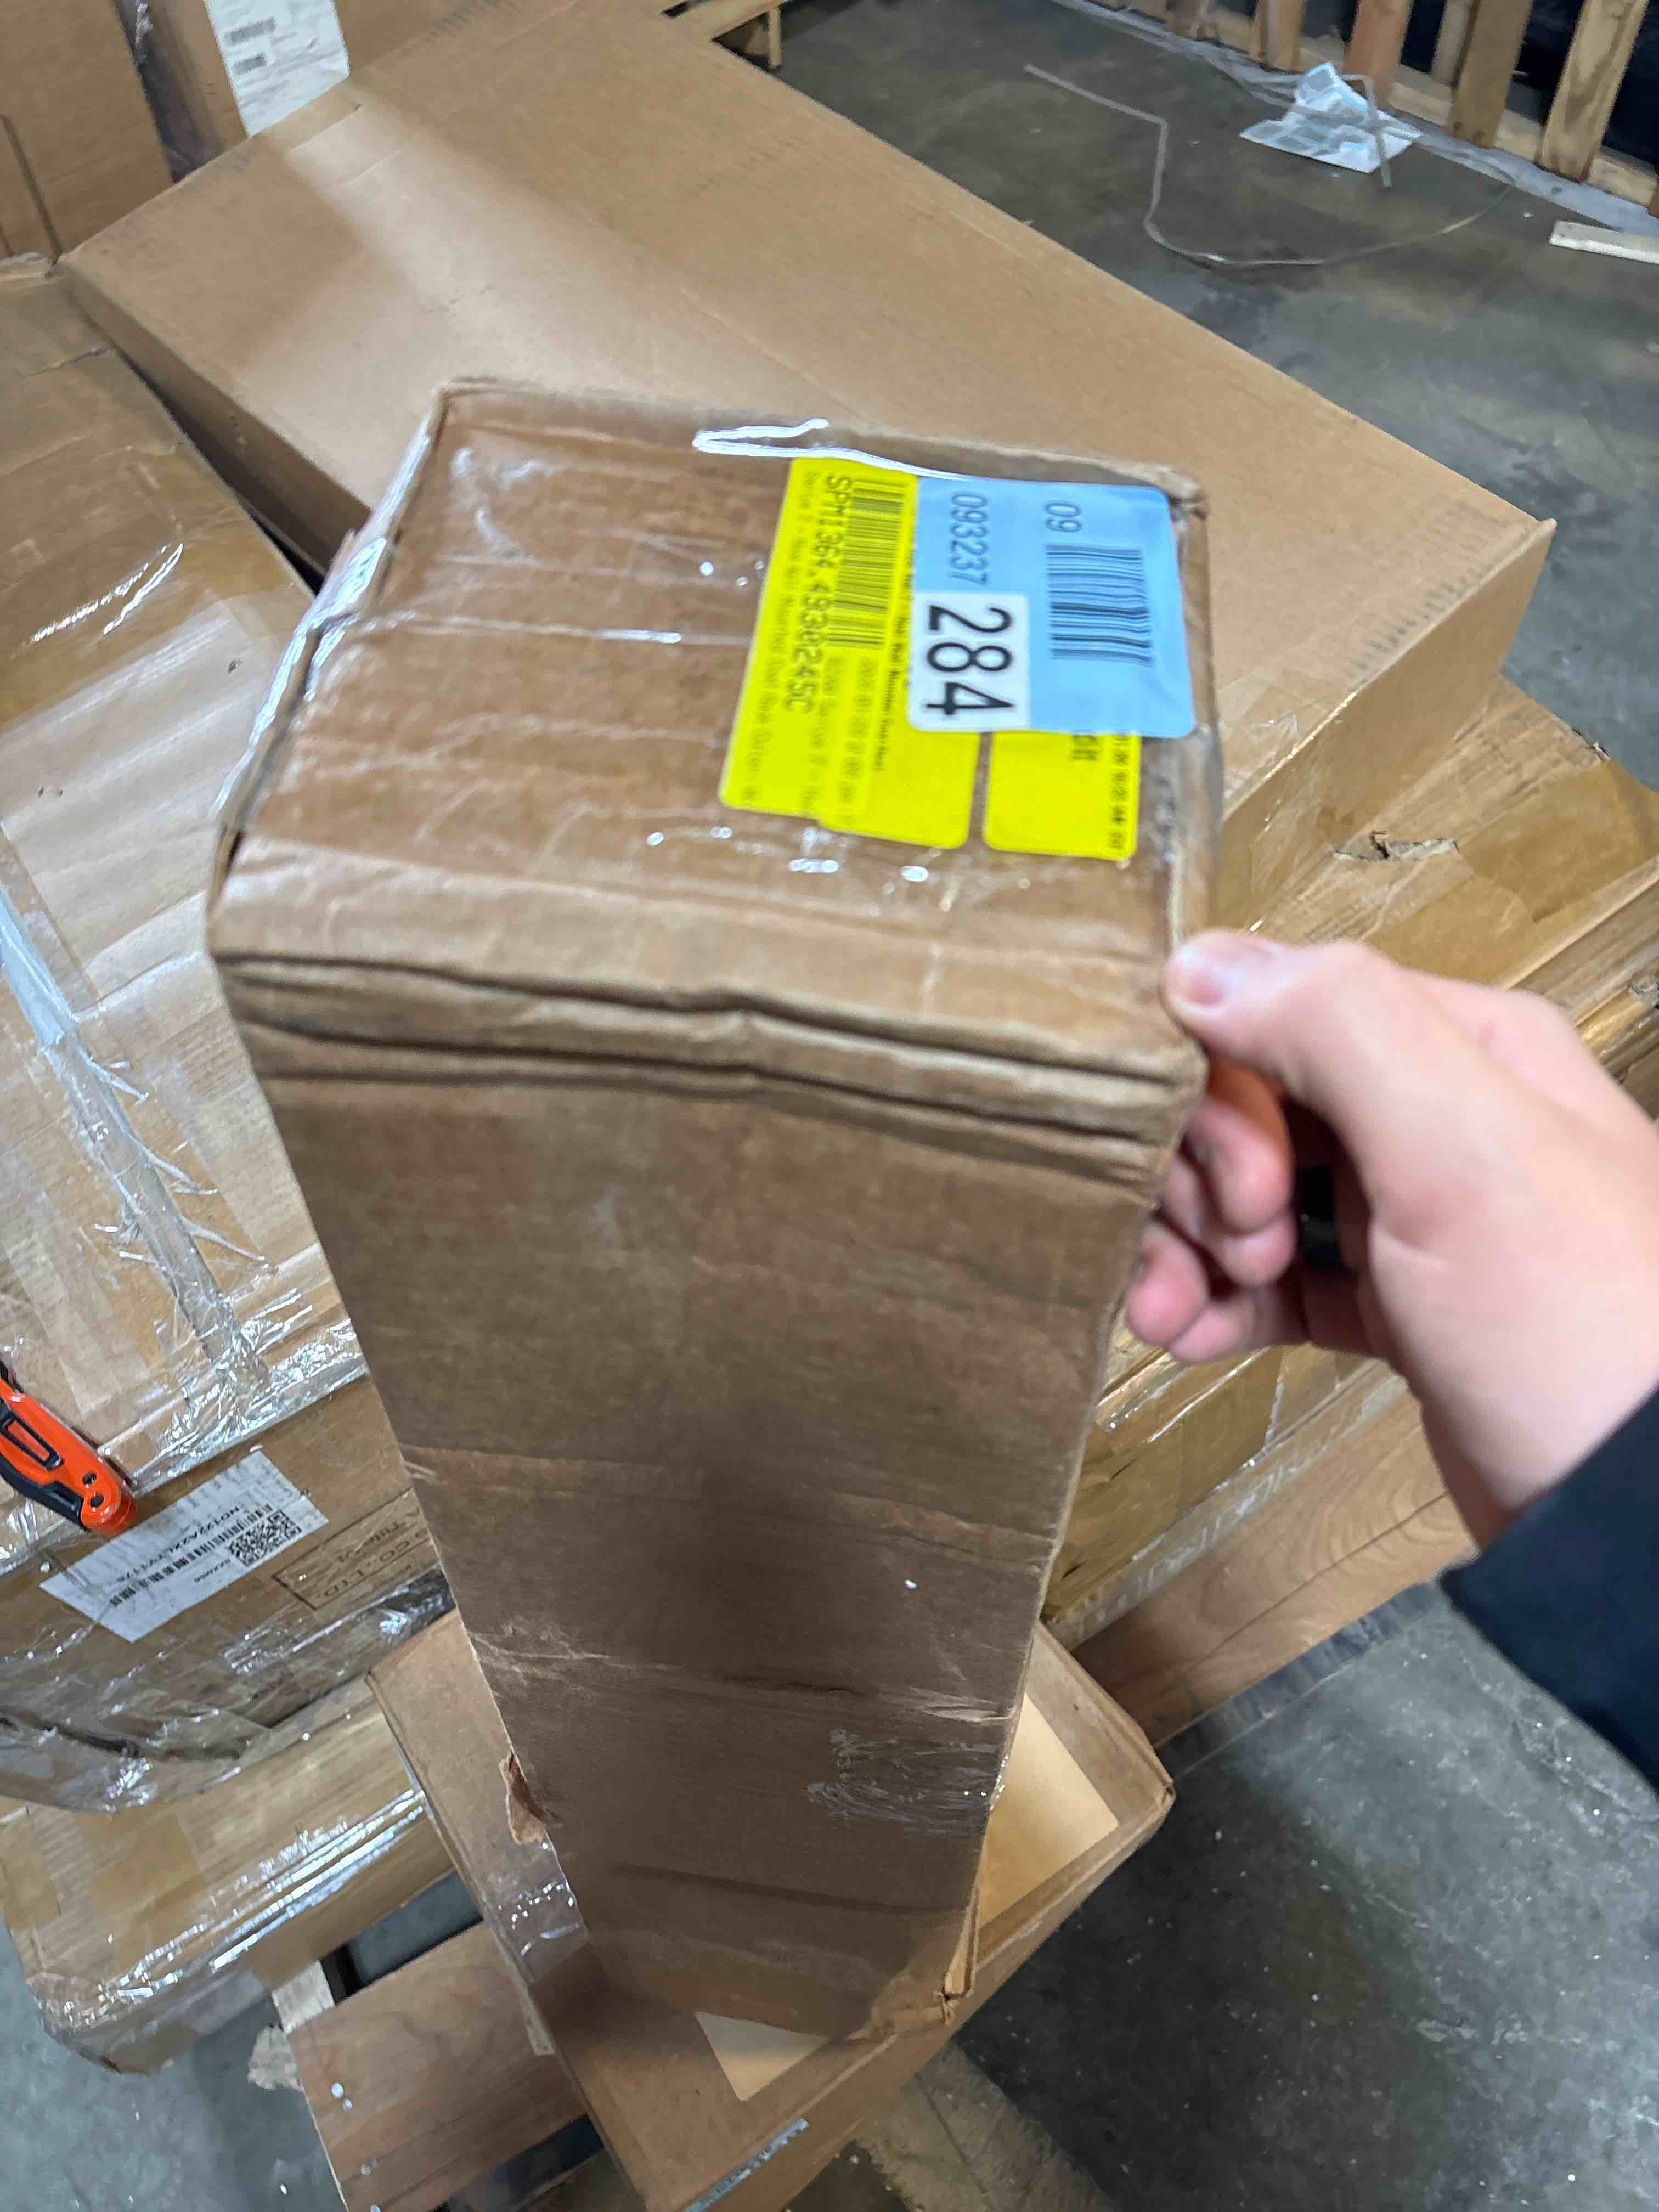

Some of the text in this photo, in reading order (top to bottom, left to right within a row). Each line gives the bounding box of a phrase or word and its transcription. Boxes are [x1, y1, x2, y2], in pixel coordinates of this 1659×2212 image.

[947, 493, 989, 585] 093237
[1043, 502, 1082, 533] 09
[923, 604, 1016, 716] 284
